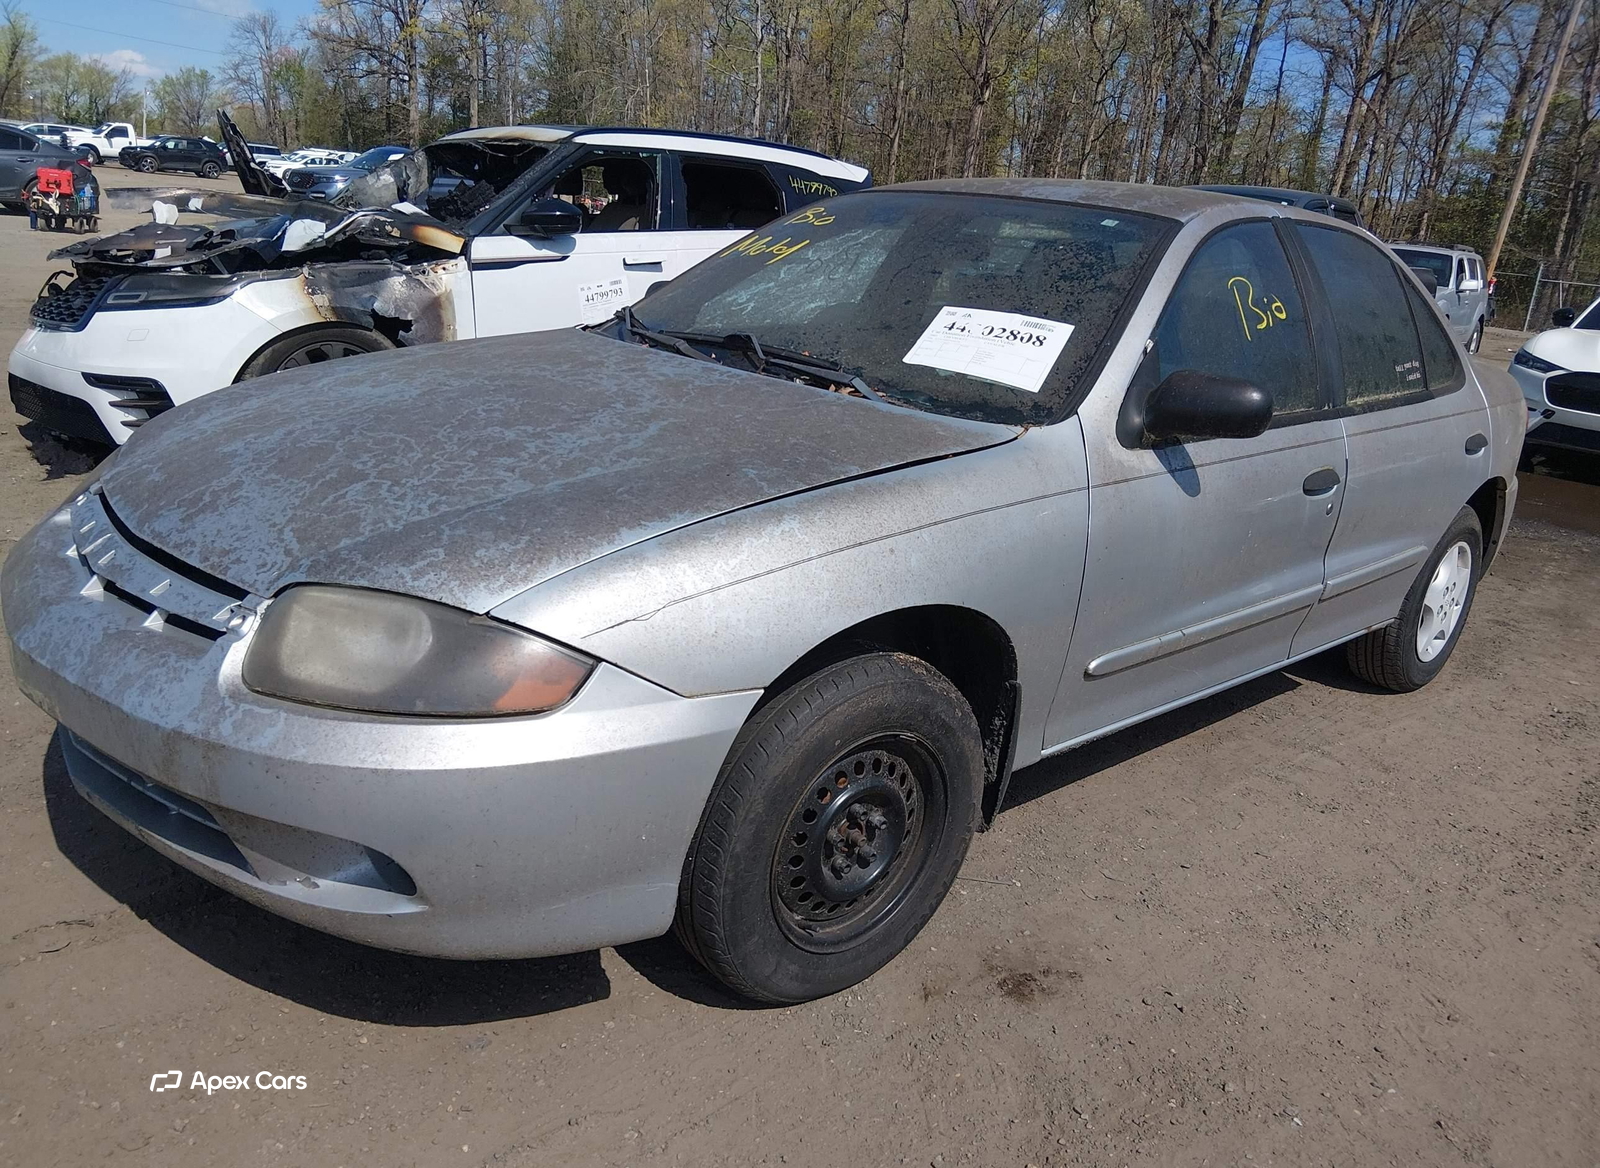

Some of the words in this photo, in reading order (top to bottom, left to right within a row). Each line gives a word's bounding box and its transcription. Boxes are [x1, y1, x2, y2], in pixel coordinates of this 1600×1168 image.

[784, 207, 836, 226] Bio
[719, 235, 810, 265] Mold
[584, 287, 624, 303] 44799793
[1228, 276, 1287, 341] Bio
[943, 320, 1047, 348] 4402808
